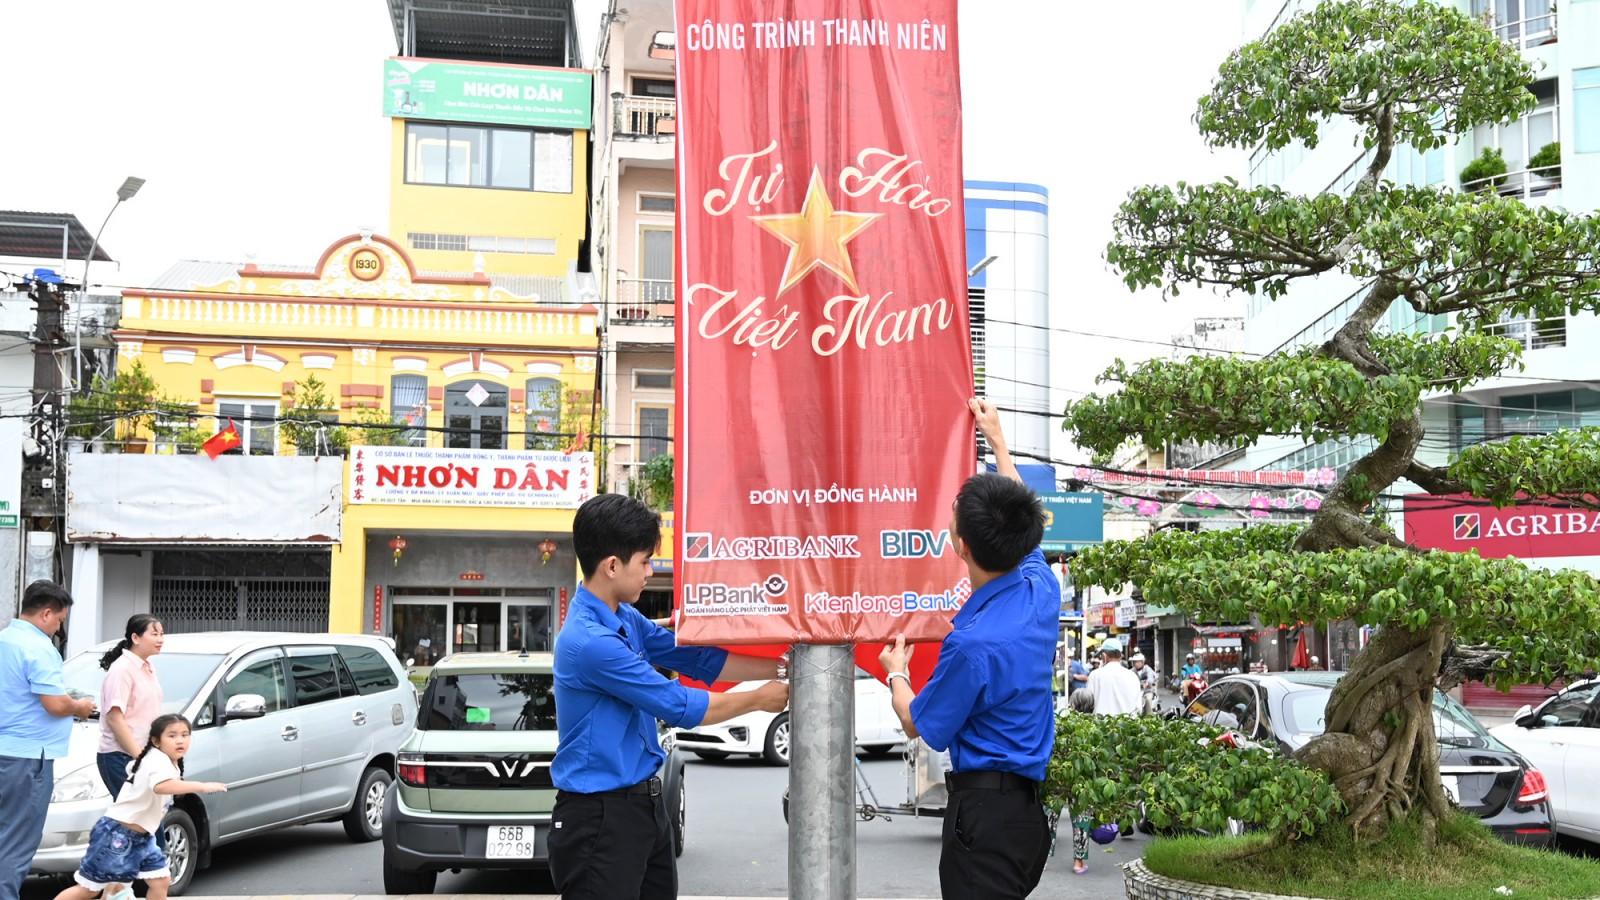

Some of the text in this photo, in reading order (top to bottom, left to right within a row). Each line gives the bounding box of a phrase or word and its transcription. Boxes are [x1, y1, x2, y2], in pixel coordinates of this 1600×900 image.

[687, 18, 946, 51] CÔNG TRÌNH THANH NIÊN
[464, 80, 563, 102] NHƠN DÂN
[703, 139, 784, 216] Tự
[356, 259, 377, 270] 1930
[688, 283, 953, 357] Việt Nam
[376, 463, 478, 489] NHƠN
[493, 462, 569, 490] DÂN
[750, 482, 917, 507] ĐƠN VỊ ĐỒNG HÀNH
[1078, 496, 1092, 504] NAM
[716, 536, 858, 558] AGRIBANK
[882, 532, 948, 556] BIDV
[686, 585, 765, 605] LPBank
[807, 592, 958, 614] KienlongBank
[706, 606, 725, 614] HÀNG
[726, 605, 740, 614] LỘC
[758, 604, 771, 612] VIỆT
[499, 826, 523, 841] 68B
